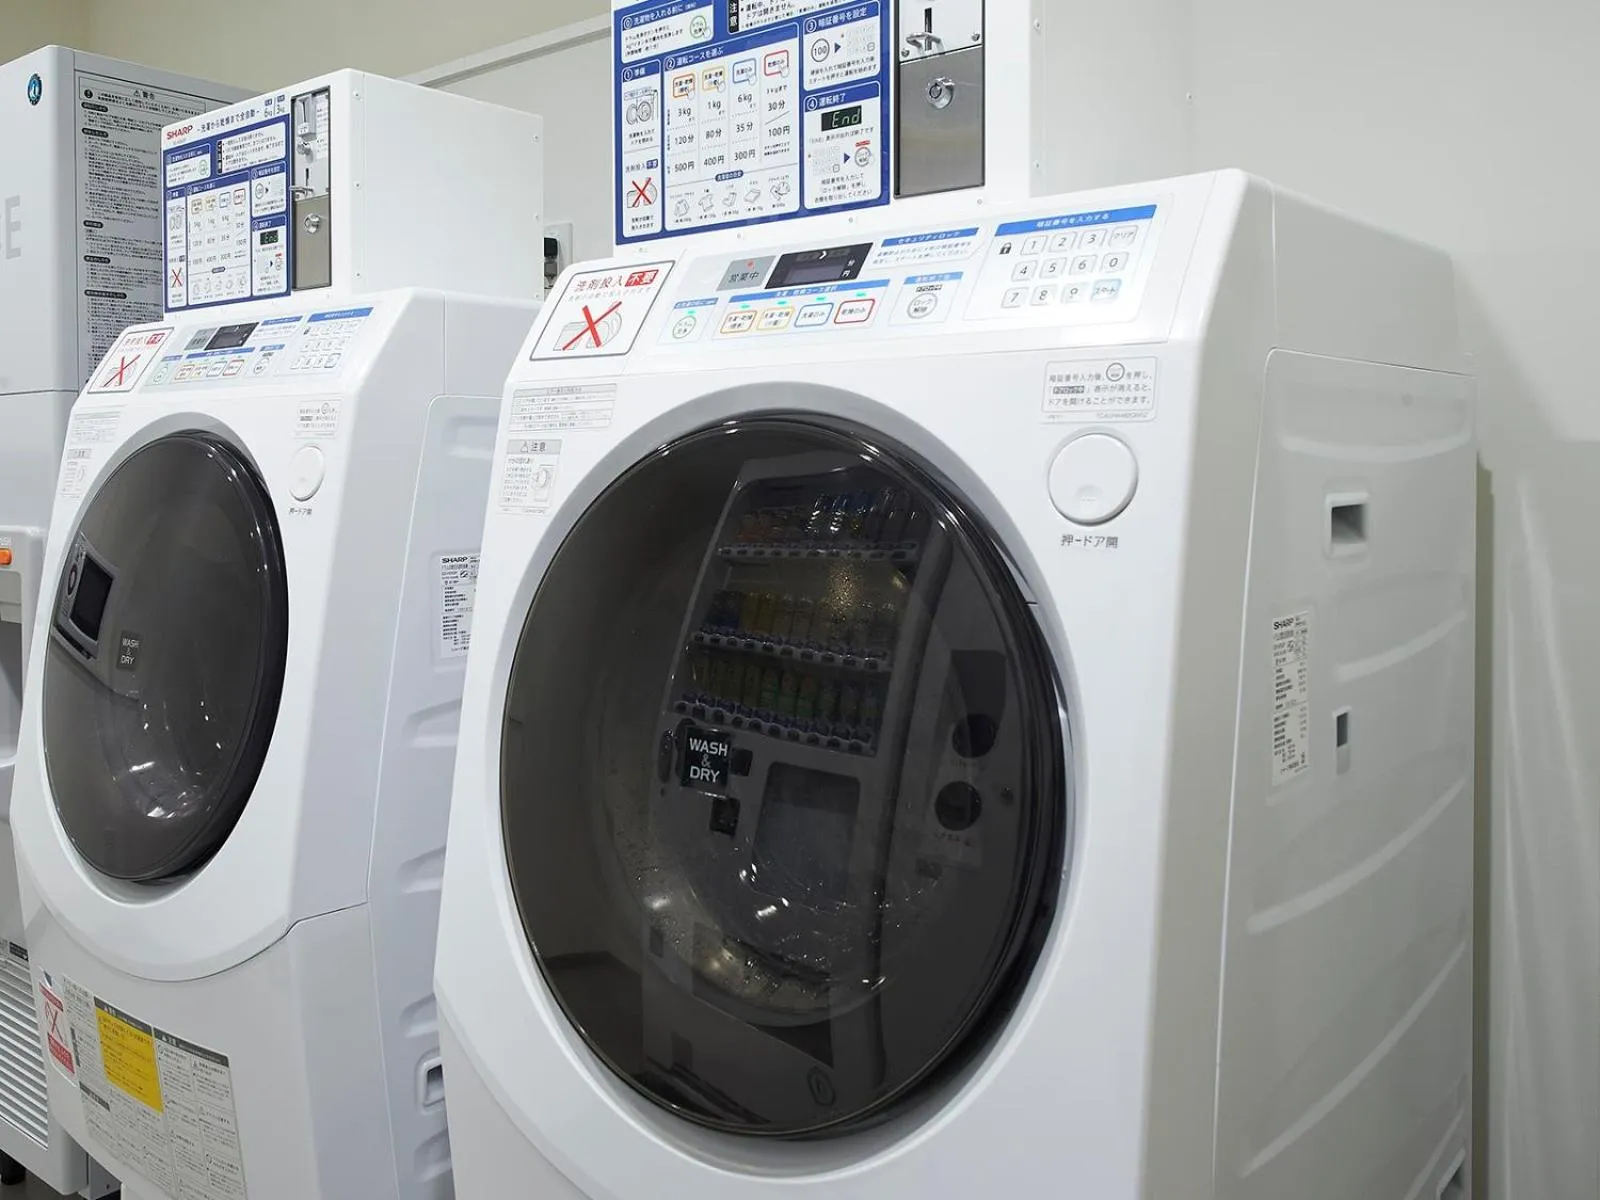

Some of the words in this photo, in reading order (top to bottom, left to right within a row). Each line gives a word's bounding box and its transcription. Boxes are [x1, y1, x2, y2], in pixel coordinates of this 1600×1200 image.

[819, 7, 867, 27] 暗証番号を設定
[814, 45, 827, 57] 100
[738, 93, 752, 103] 6kg
[768, 99, 785, 111] 30分
[832, 108, 860, 128] End
[166, 124, 193, 140] SHARP
[706, 128, 721, 139] 80分
[736, 122, 753, 133] 35分
[769, 125, 790, 137] 100円
[675, 134, 694, 145] 120分
[704, 155, 724, 167] 400円
[735, 149, 755, 161] 300円
[675, 160, 694, 172] 500円
[1035, 213, 1110, 229] 暗証番号を入力する
[1031, 240, 1037, 249] 1
[1058, 237, 1067, 247] 2
[1088, 233, 1097, 244] 3
[1019, 265, 1028, 276] 4
[1049, 262, 1057, 273] 5
[1078, 259, 1087, 270] 6
[1109, 257, 1118, 267] 0
[574, 275, 622, 292] 洗剤投入
[728, 271, 760, 284] 営業中
[1011, 292, 1019, 303] 7
[1039, 290, 1048, 300] 8
[1070, 287, 1079, 298] 9
[1273, 617, 1294, 631] SHARP
[122, 638, 140, 648] WASH
[120, 655, 135, 664] DRY
[689, 737, 729, 757] WASH
[700, 754, 712, 769] &
[689, 766, 721, 784] DRY
